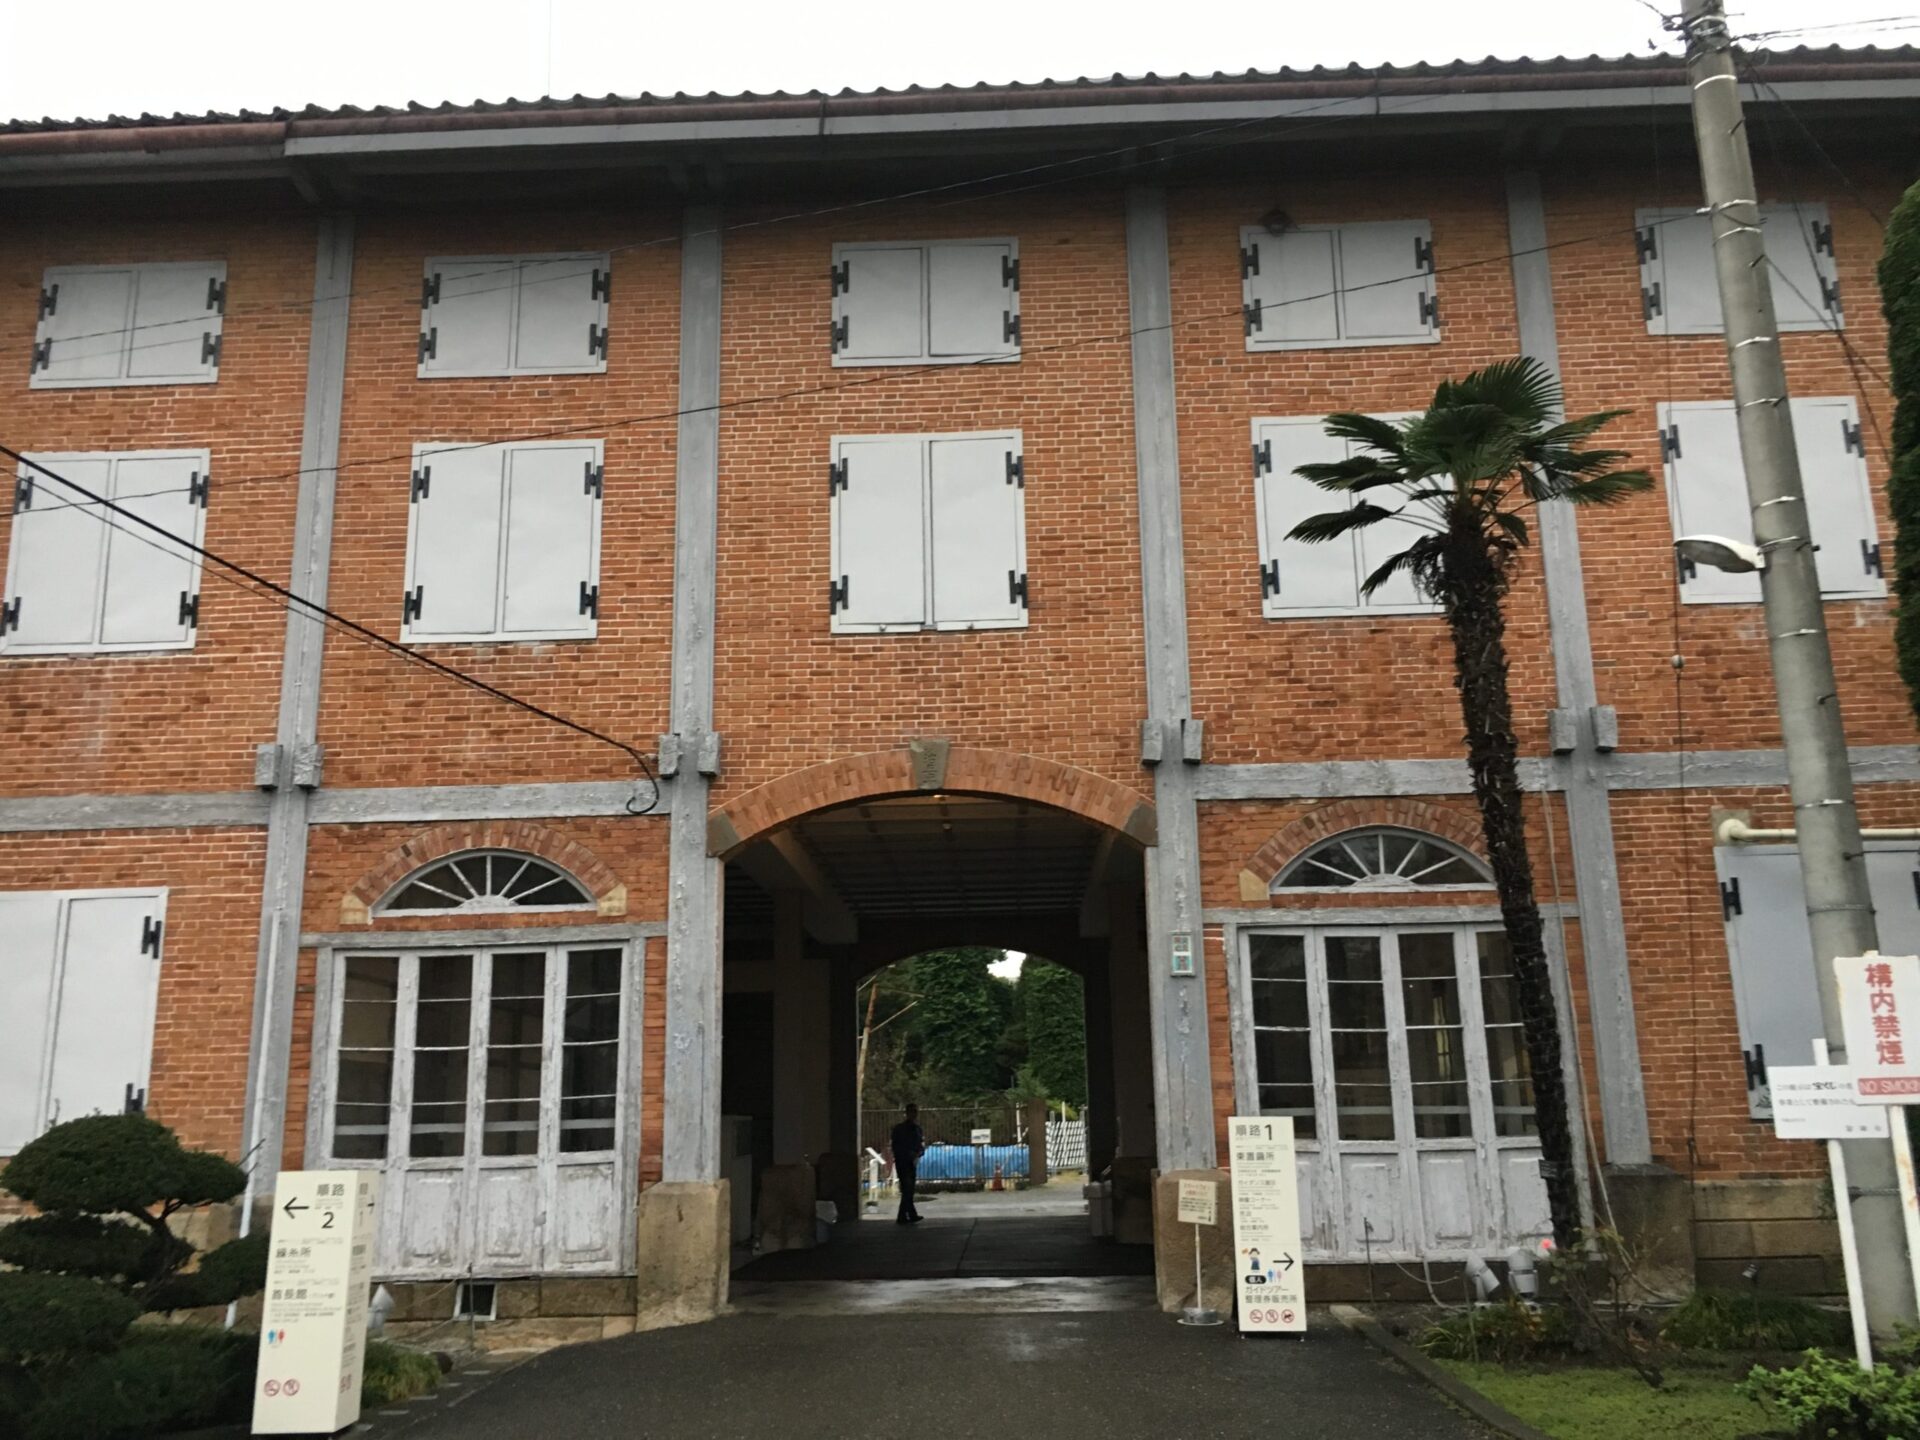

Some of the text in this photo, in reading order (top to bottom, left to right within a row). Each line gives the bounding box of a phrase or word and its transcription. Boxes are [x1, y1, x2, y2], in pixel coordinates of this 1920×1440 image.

[1865, 963, 1906, 1065] 構内禁煙
[1859, 1080, 1877, 1093] NO
[1235, 1124, 1273, 1141] 順路 1
[316, 1183, 345, 1197] 順路
[320, 1211, 335, 1229] 2
[1245, 1286, 1289, 1294] ガイドツアー
